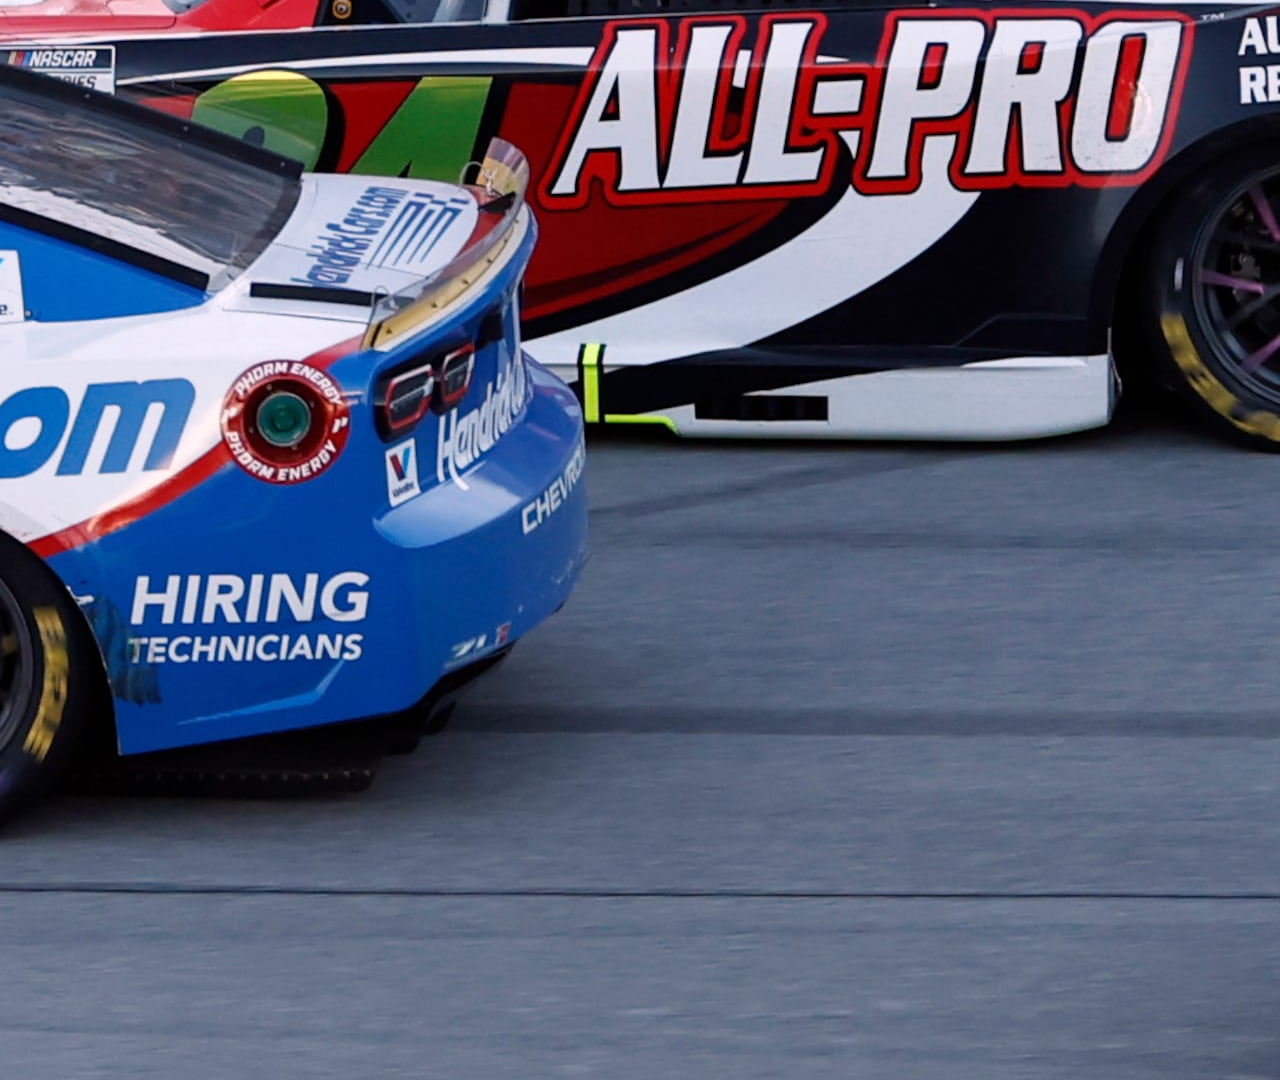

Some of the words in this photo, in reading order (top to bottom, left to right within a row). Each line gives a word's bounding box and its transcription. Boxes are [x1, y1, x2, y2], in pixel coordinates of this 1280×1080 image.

[29, 51, 97, 67] NASCAR
[550, 20, 1183, 194] ALL-PRO
[234, 362, 288, 399] PHORM
[290, 363, 343, 406] ENERGY
[226, 430, 275, 479] PHORM
[277, 440, 337, 481] ENERGY
[130, 570, 371, 625] HIRING
[128, 633, 364, 664] TECHNICIANS
